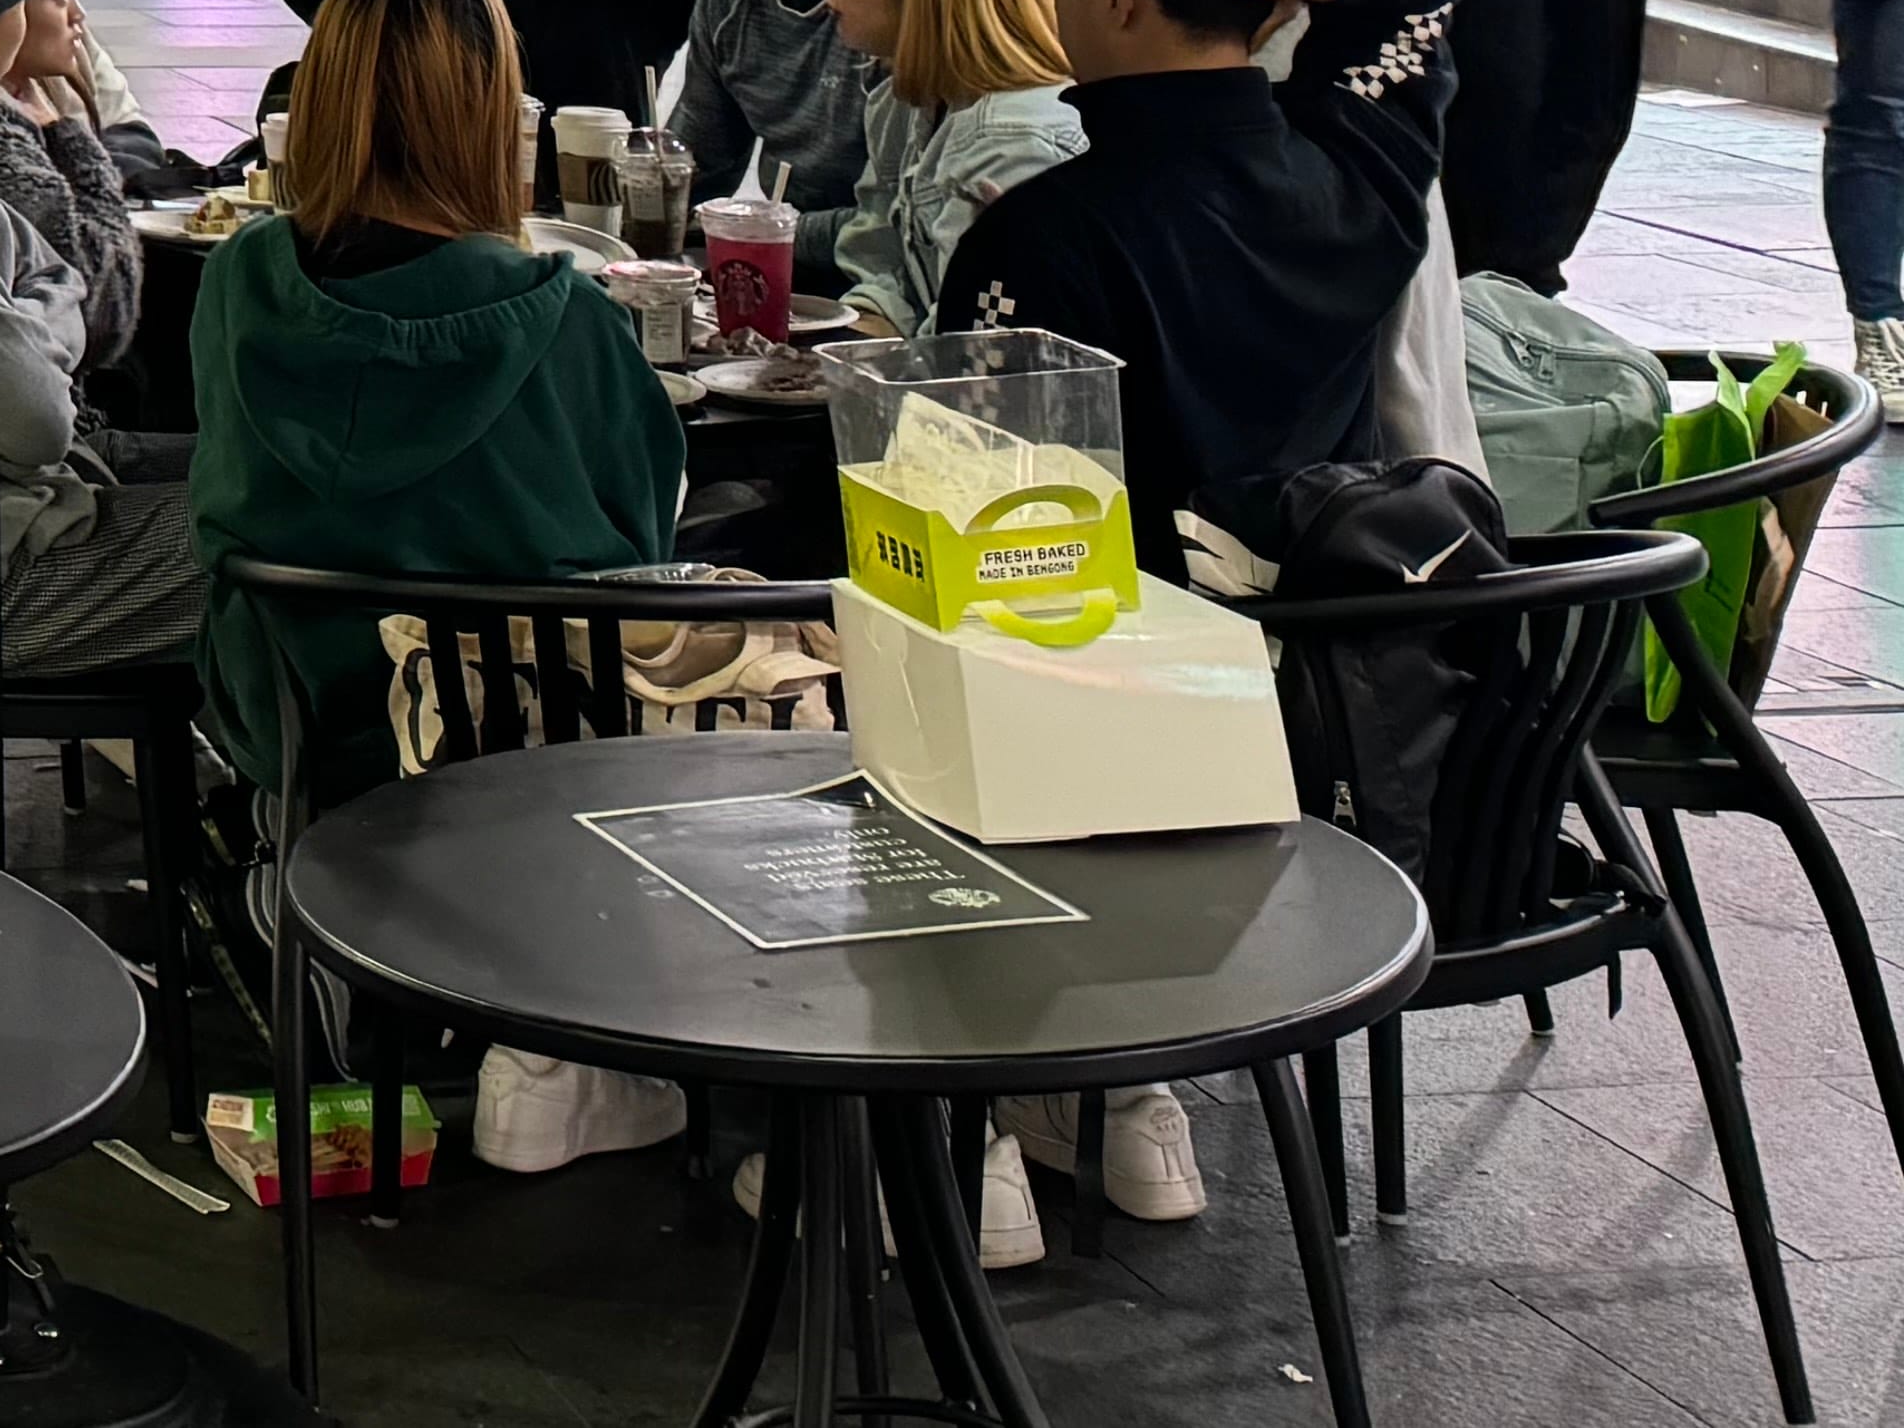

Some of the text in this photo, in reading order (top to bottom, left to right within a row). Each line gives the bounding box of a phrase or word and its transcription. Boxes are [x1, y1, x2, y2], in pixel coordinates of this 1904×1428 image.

[984, 543, 1085, 565] FRESH BAKED
[979, 560, 1075, 580] MADE IN BENGONG
